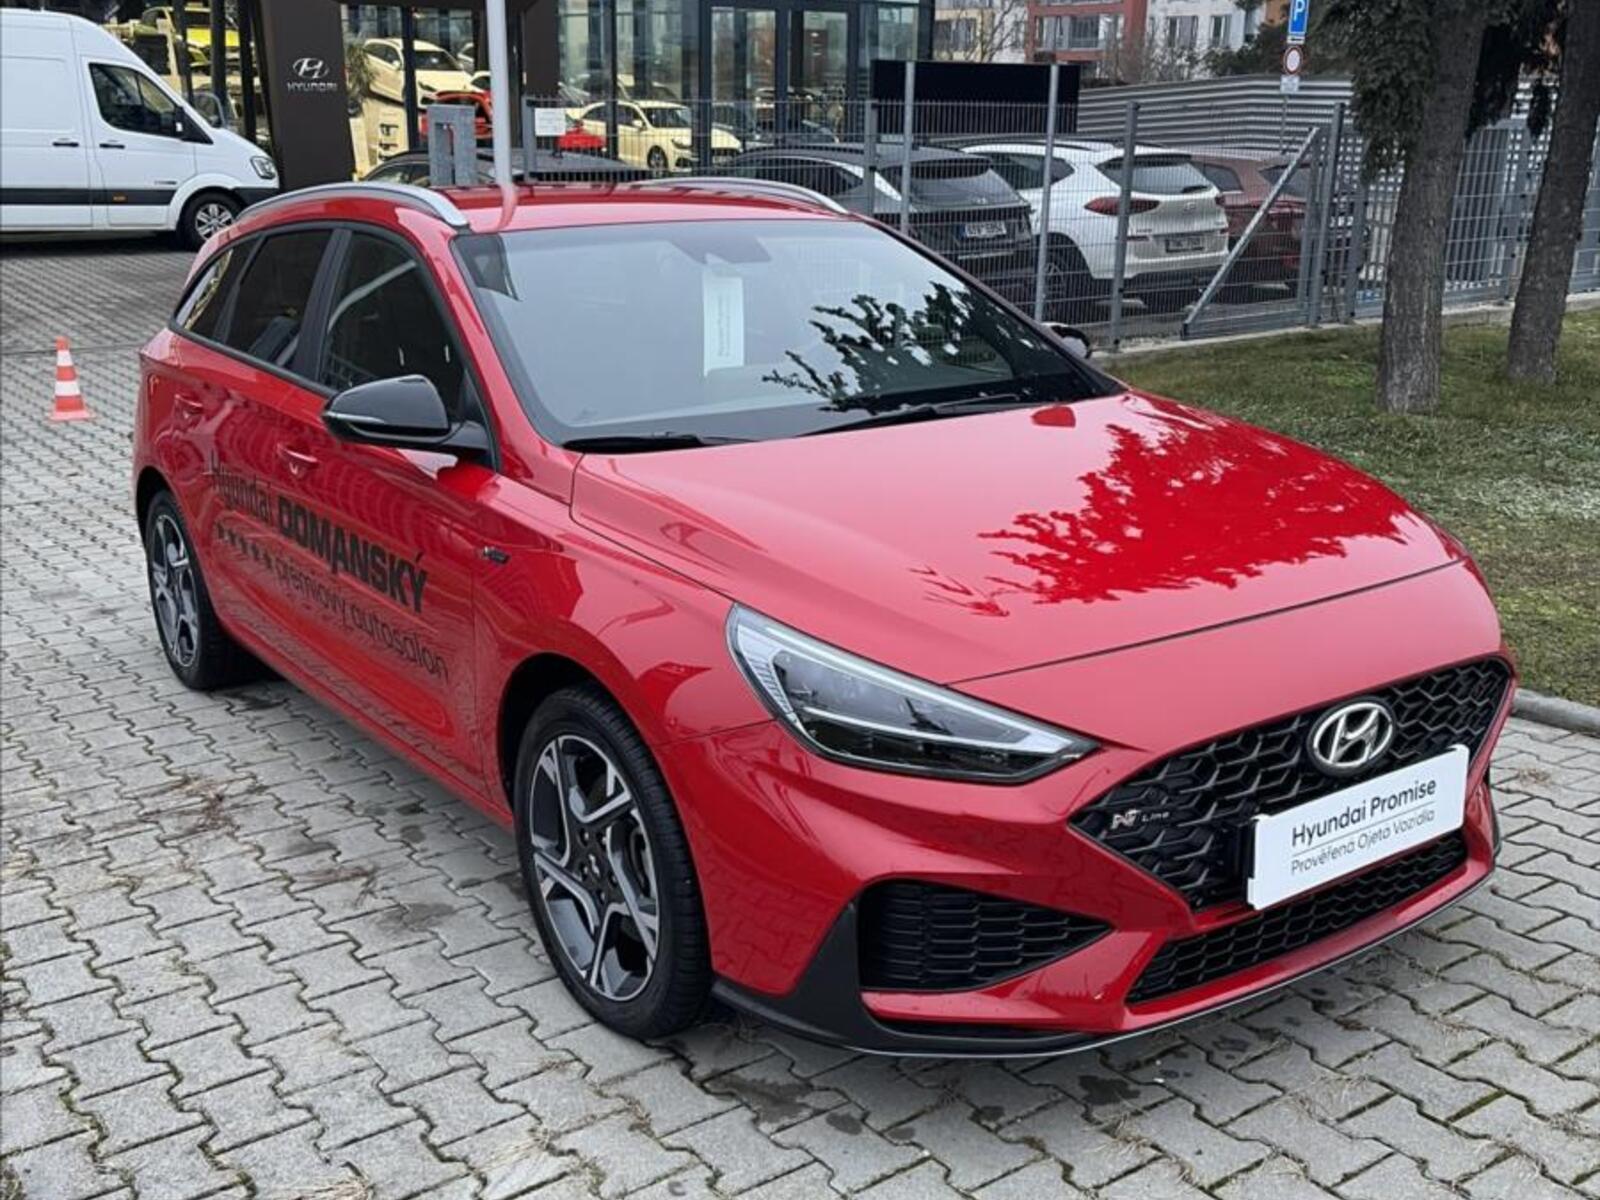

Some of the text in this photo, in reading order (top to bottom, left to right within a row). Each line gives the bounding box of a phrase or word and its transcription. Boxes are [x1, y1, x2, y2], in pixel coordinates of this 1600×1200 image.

[287, 82, 337, 92] HYUNDAI
[211, 466, 428, 614] Hyundai DOMANSKÝ
[352, 604, 450, 686] autosalon
[1292, 779, 1437, 846] Hyundai Promise
[1393, 809, 1436, 834] Vozidla
